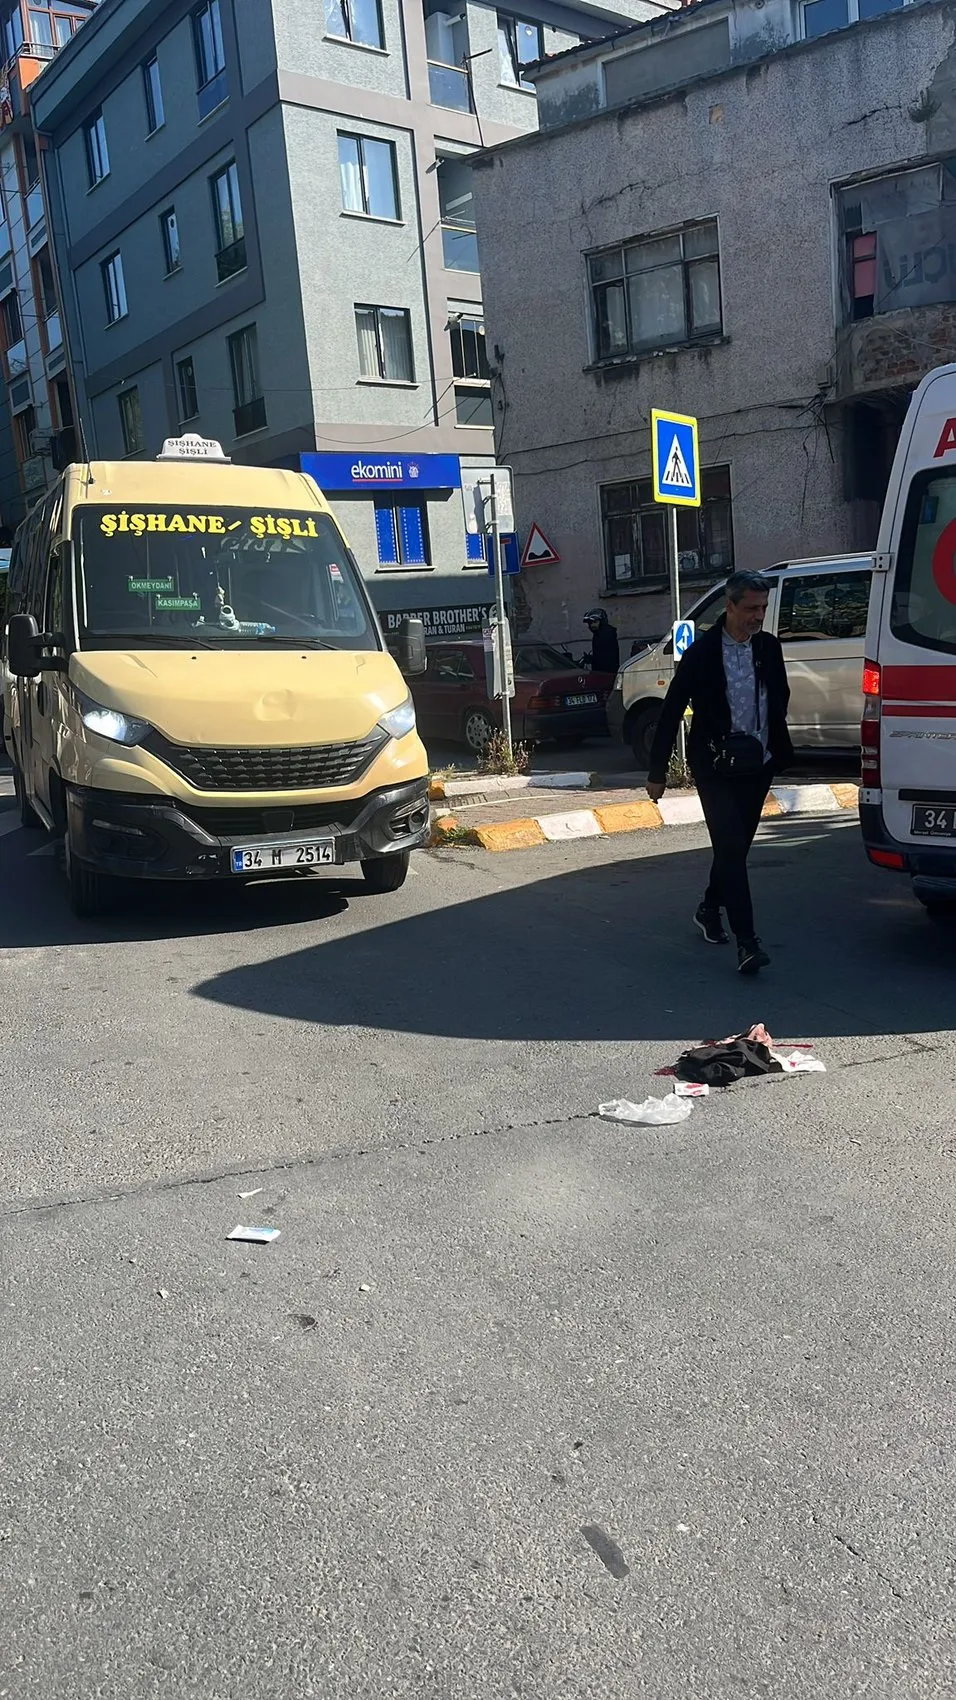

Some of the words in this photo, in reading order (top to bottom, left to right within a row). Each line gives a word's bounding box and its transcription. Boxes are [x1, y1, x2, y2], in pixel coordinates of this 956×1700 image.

[351, 460, 403, 479] ekomini
[100, 510, 226, 537] ŞİŞHANE
[250, 514, 319, 540] ŞİŞLİ
[432, 606, 487, 625] BROTHER'S
[438, 625, 445, 635] &
[444, 623, 466, 634] TURAN
[924, 809, 947, 829] 34
[244, 850, 263, 868] 34
[271, 849, 282, 865] M
[296, 845, 331, 863] 2514
